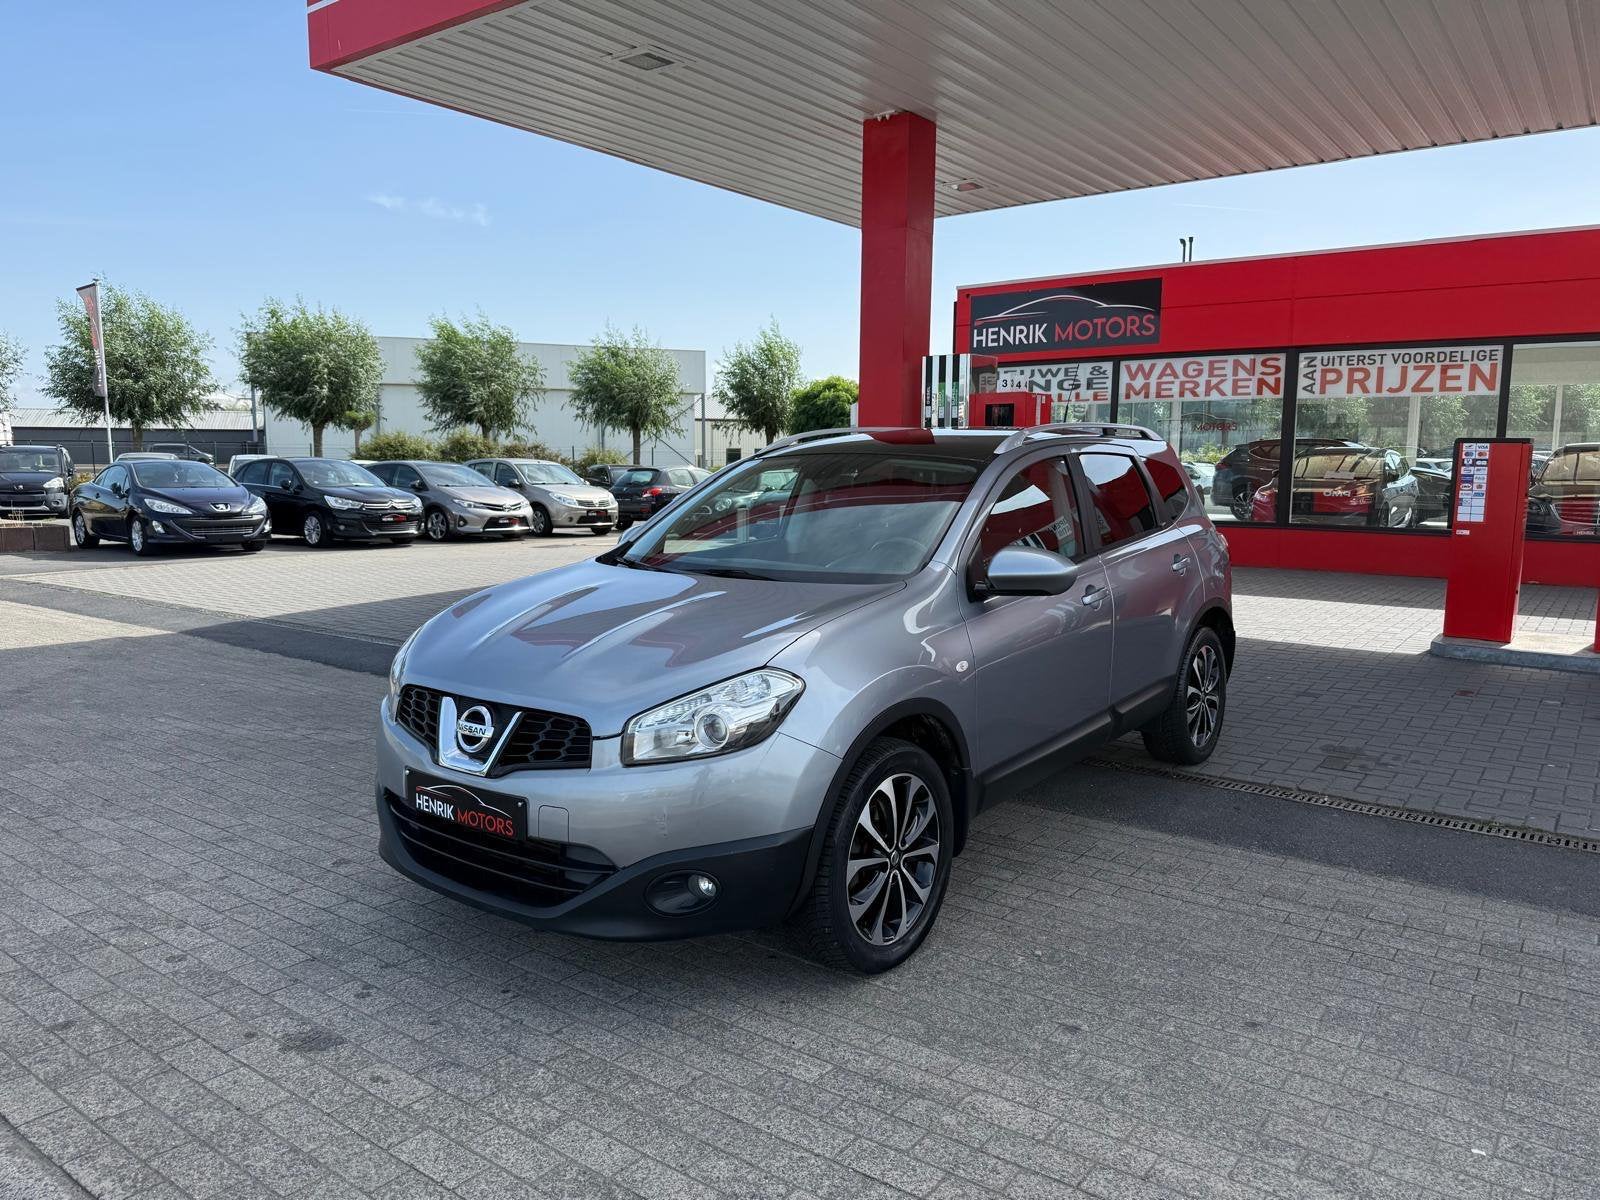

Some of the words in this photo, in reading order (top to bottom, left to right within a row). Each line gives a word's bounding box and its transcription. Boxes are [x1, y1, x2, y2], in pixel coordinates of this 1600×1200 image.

[973, 323, 1048, 348] HENRIK
[1055, 314, 1156, 343] MOTORS
[1124, 357, 1282, 382] WAGENS
[1320, 353, 1387, 367] UITERST
[1391, 349, 1499, 365] VOORDELIGE
[1089, 365, 1108, 377] &
[1302, 355, 1318, 395] AAN
[1318, 362, 1499, 395] PRIJZEN
[1001, 379, 1008, 388] 3
[1027, 377, 1110, 395] NGE
[1124, 376, 1281, 400] MERKEN
[1057, 390, 1109, 403] LLE
[415, 792, 455, 820] HENRIK
[456, 808, 515, 837] MOTORS
